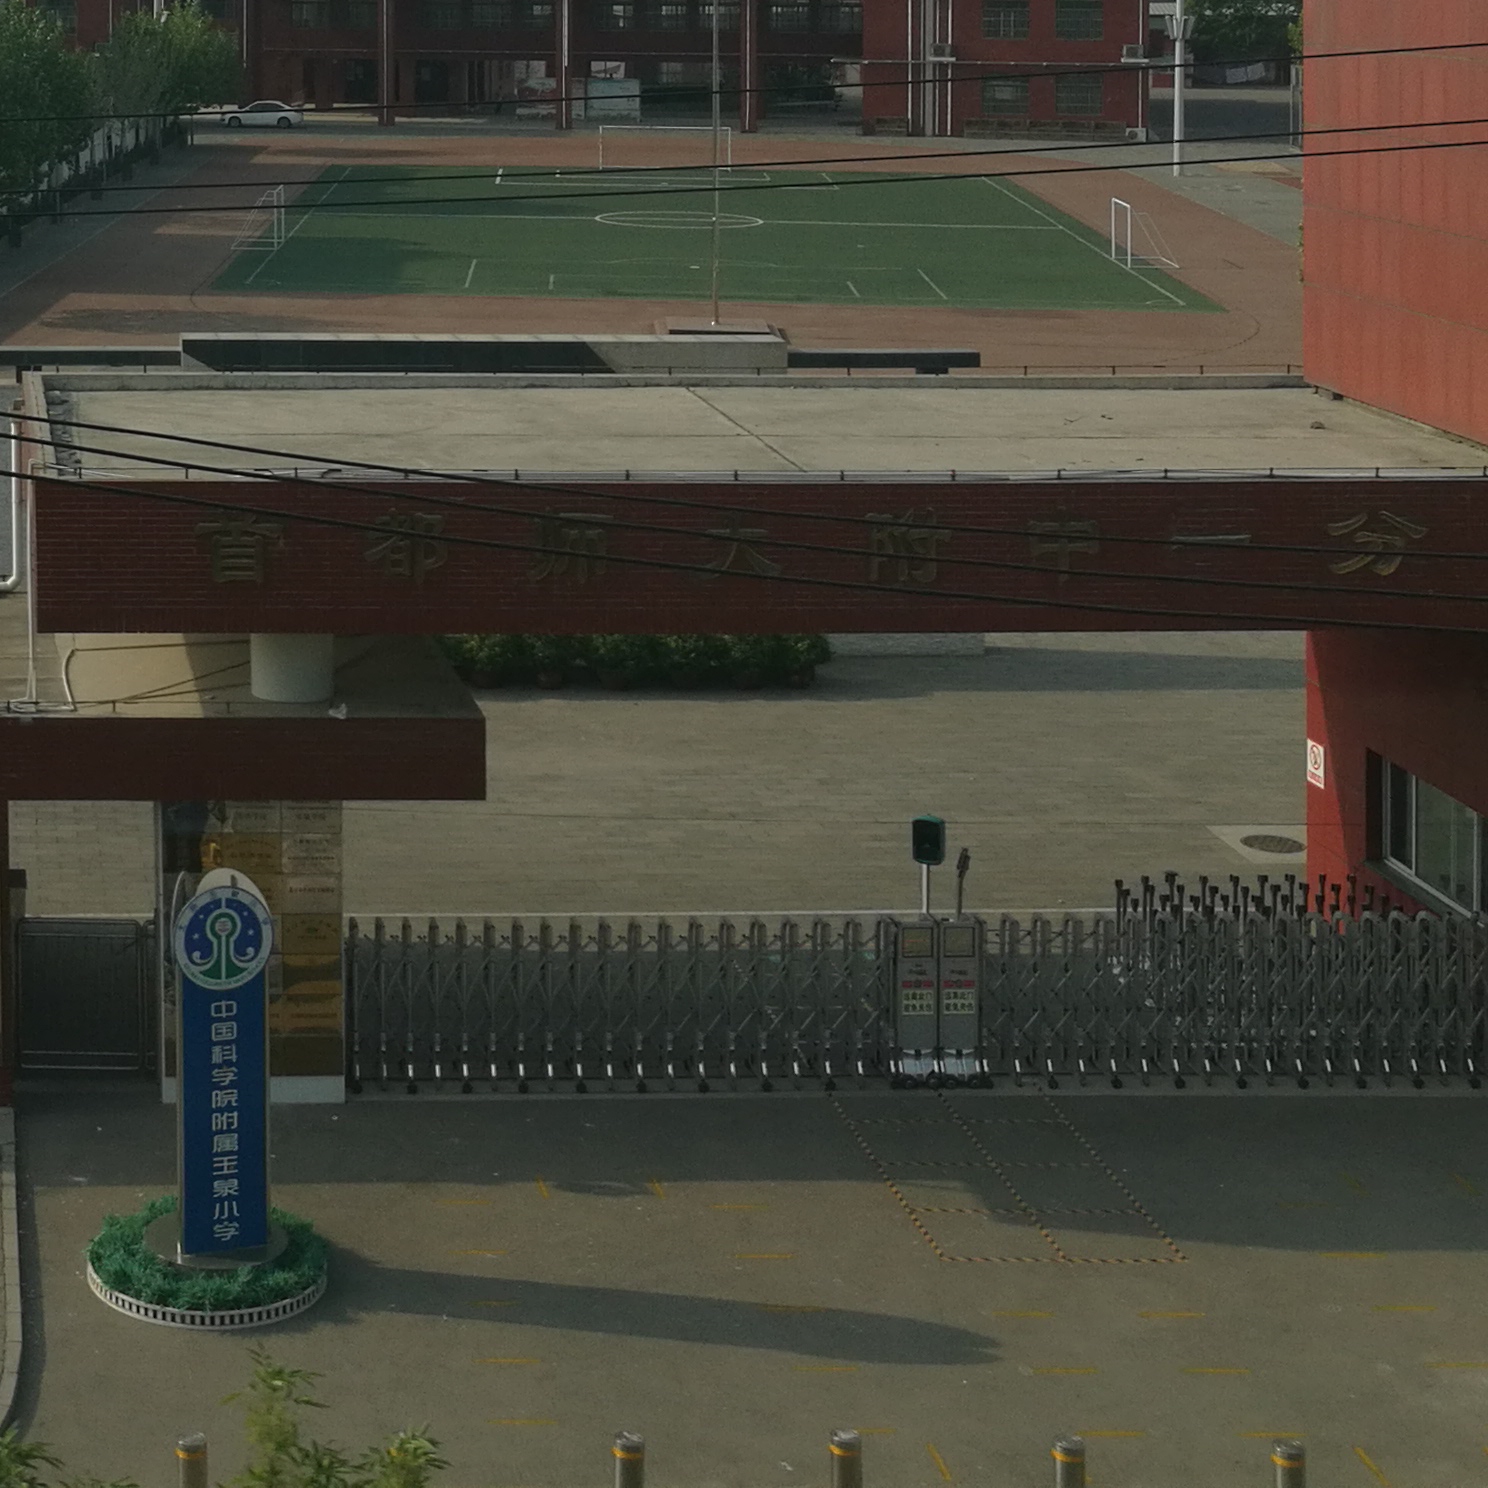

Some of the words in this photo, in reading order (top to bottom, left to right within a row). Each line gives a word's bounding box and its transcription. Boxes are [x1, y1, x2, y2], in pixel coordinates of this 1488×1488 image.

[210, 999, 240, 1242] 中国科学院附属玉泉小学
